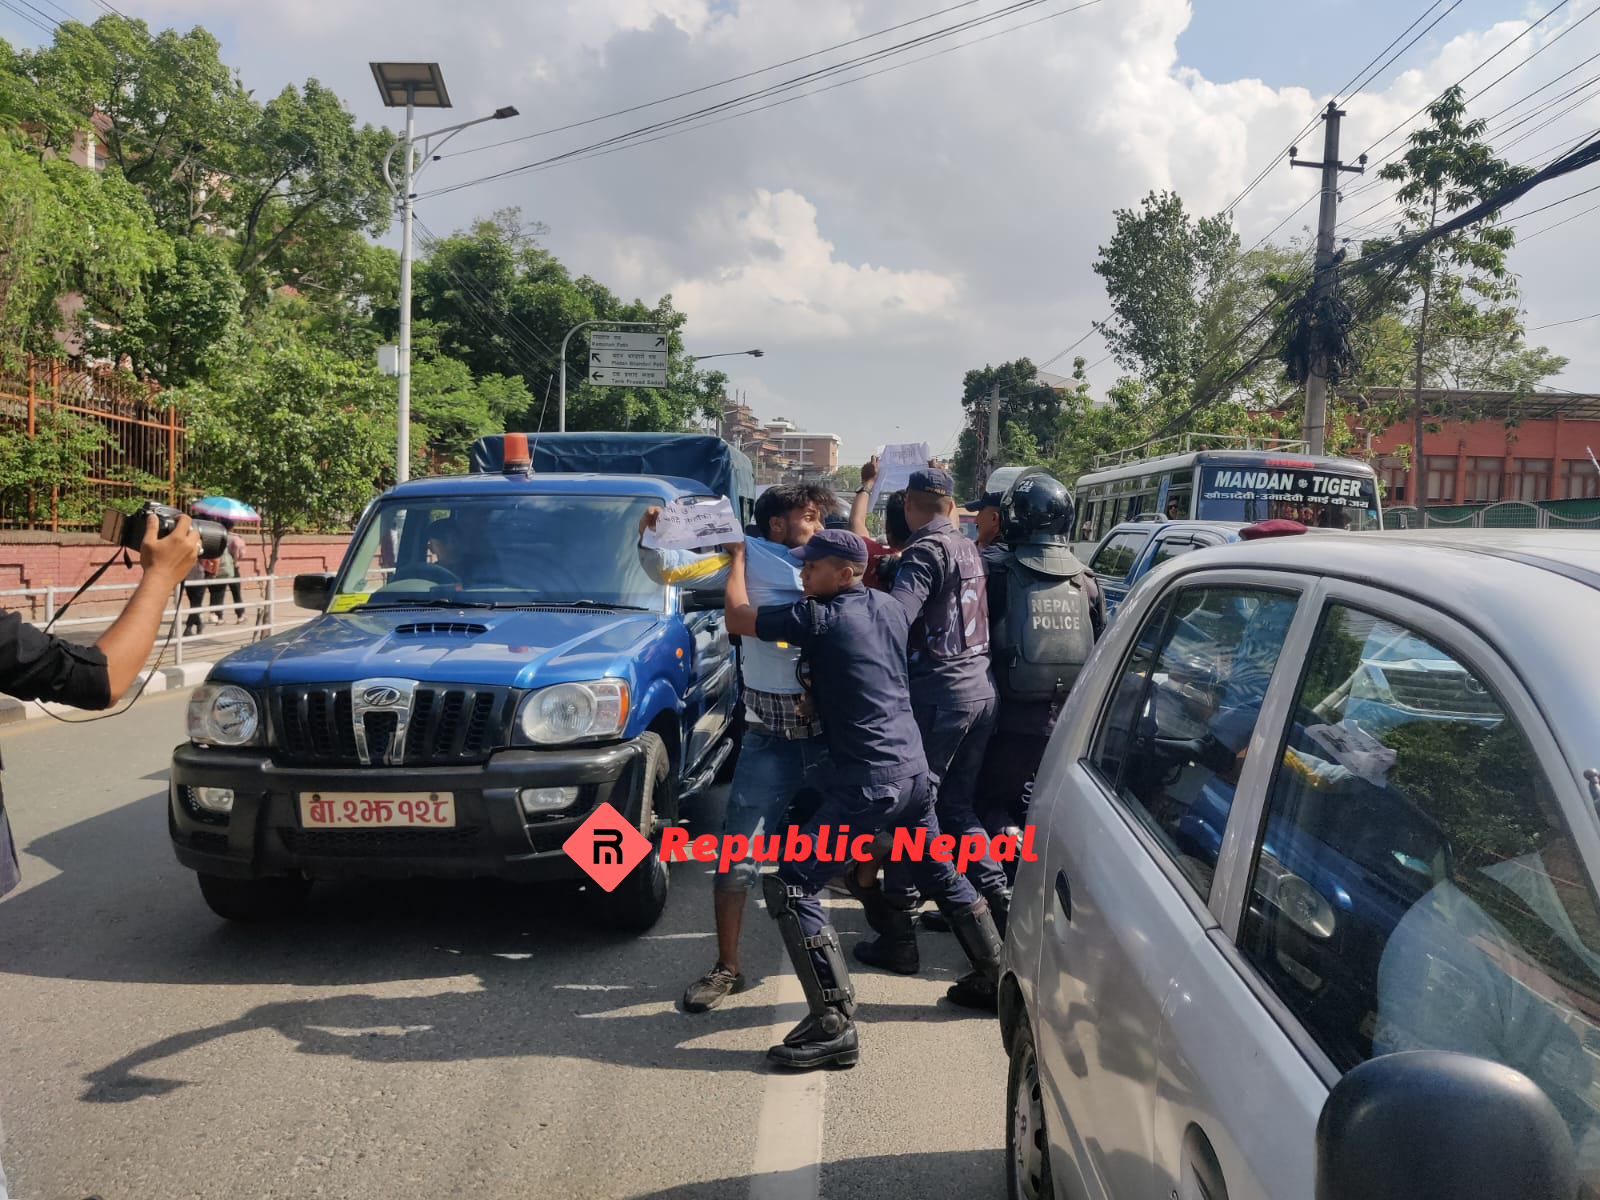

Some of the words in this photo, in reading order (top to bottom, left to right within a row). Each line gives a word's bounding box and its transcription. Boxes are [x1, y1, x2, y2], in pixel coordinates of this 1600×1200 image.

[1214, 470, 1295, 491] MANDAN
[1312, 476, 1362, 498] TIGER
[1330, 496, 1348, 507] की
[1031, 599, 1080, 614] NEPAL
[1032, 616, 1081, 630] POLICE
